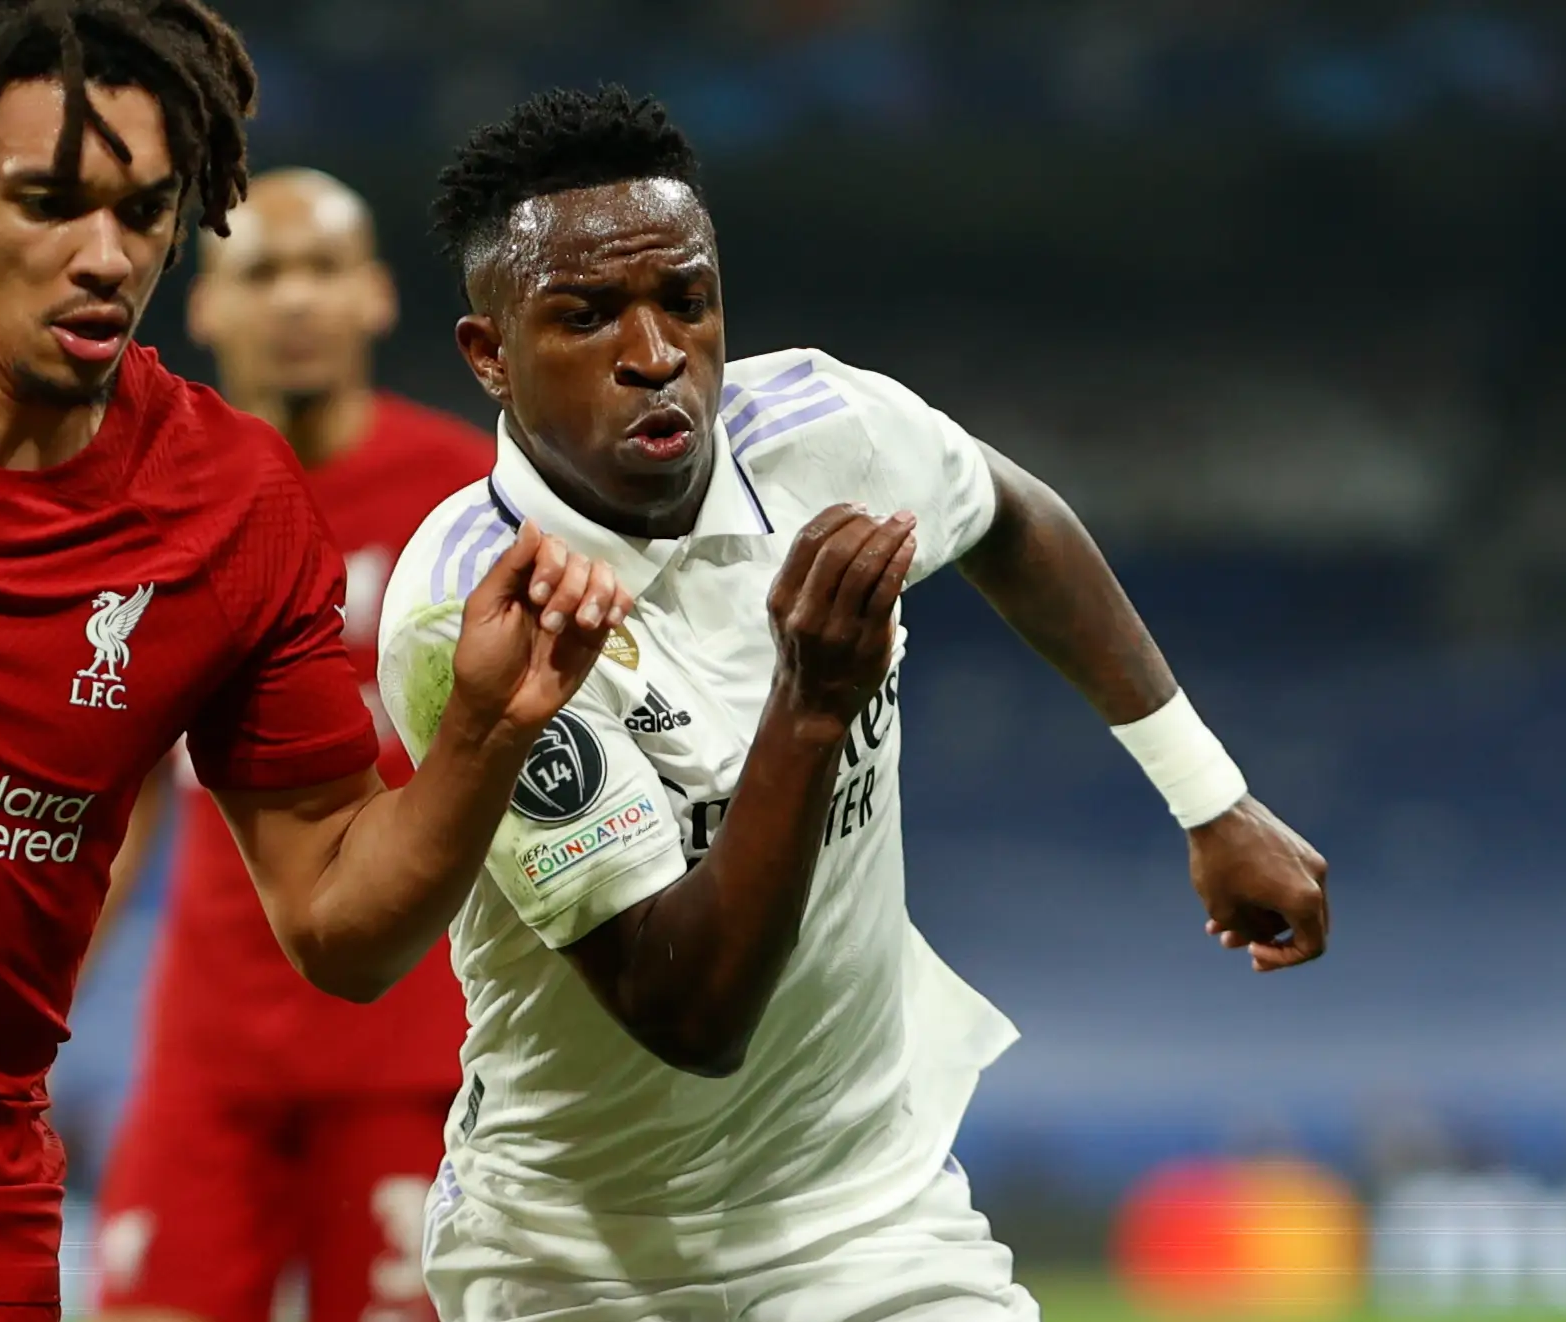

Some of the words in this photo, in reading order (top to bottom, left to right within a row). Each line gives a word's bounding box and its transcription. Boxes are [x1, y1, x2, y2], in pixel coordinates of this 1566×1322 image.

[69, 678, 128, 710] L.F.C.
[536, 760, 573, 793] 14
[824, 764, 875, 848] TER
[519, 842, 550, 867] UEFA
[524, 798, 655, 882] FOUNDATION
